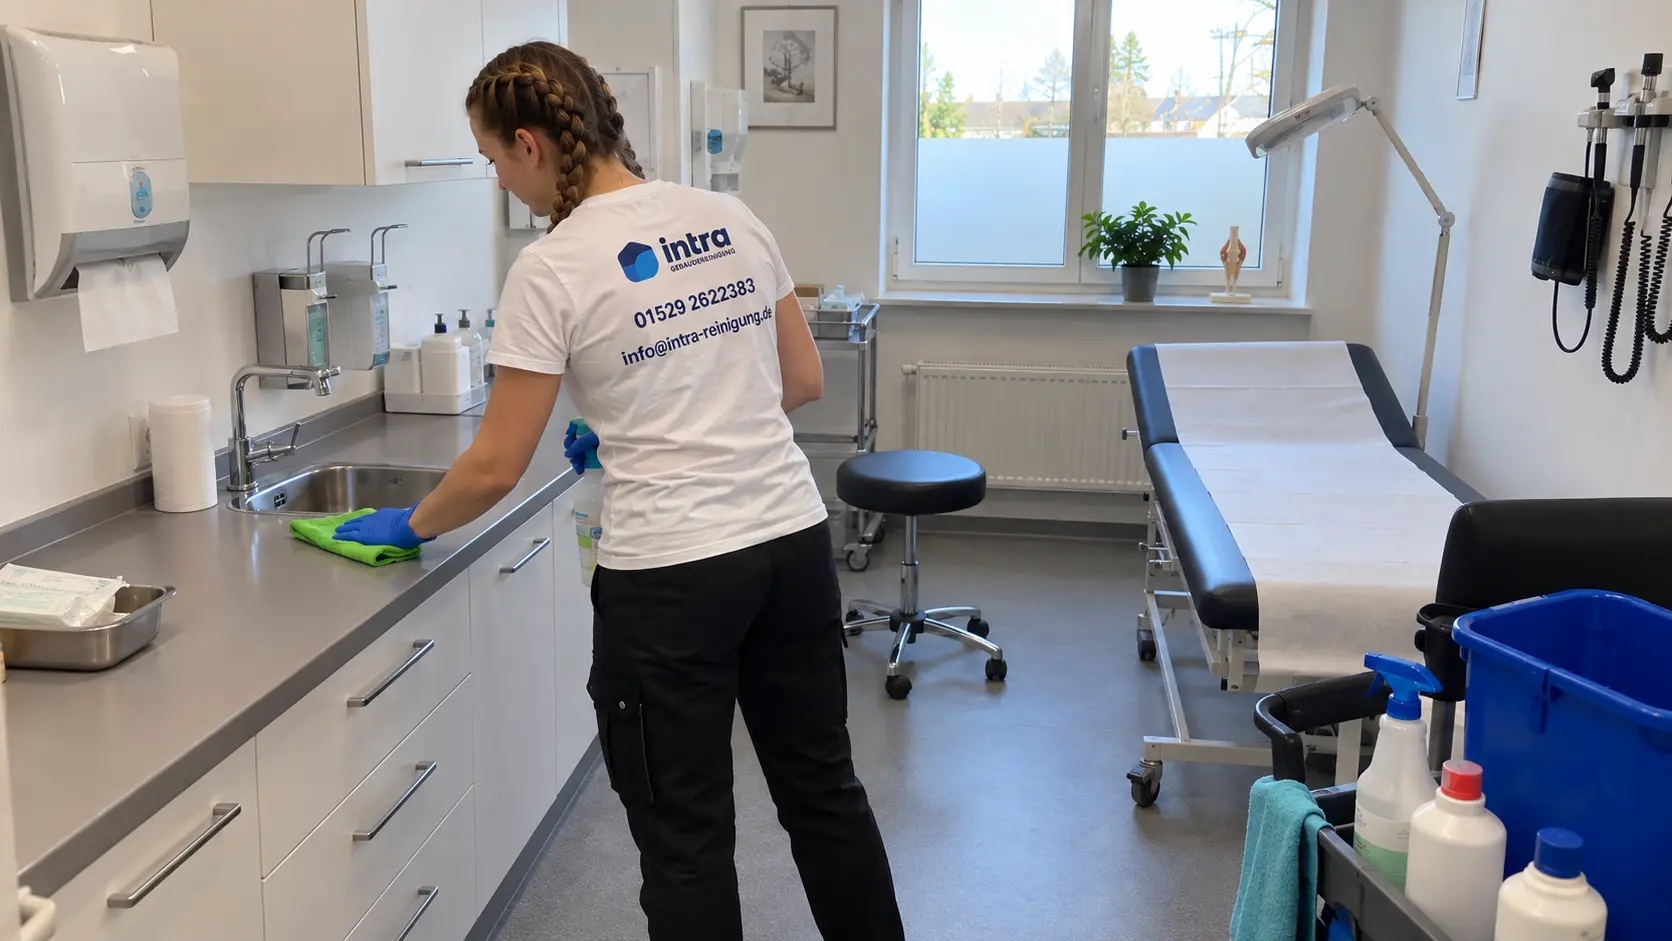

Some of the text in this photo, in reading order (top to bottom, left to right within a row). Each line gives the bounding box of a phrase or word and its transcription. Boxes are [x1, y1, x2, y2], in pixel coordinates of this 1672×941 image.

[658, 227, 732, 263] intra
[634, 277, 756, 329] 01529 2622383
[621, 305, 773, 366] info@intra-reinigung.de
